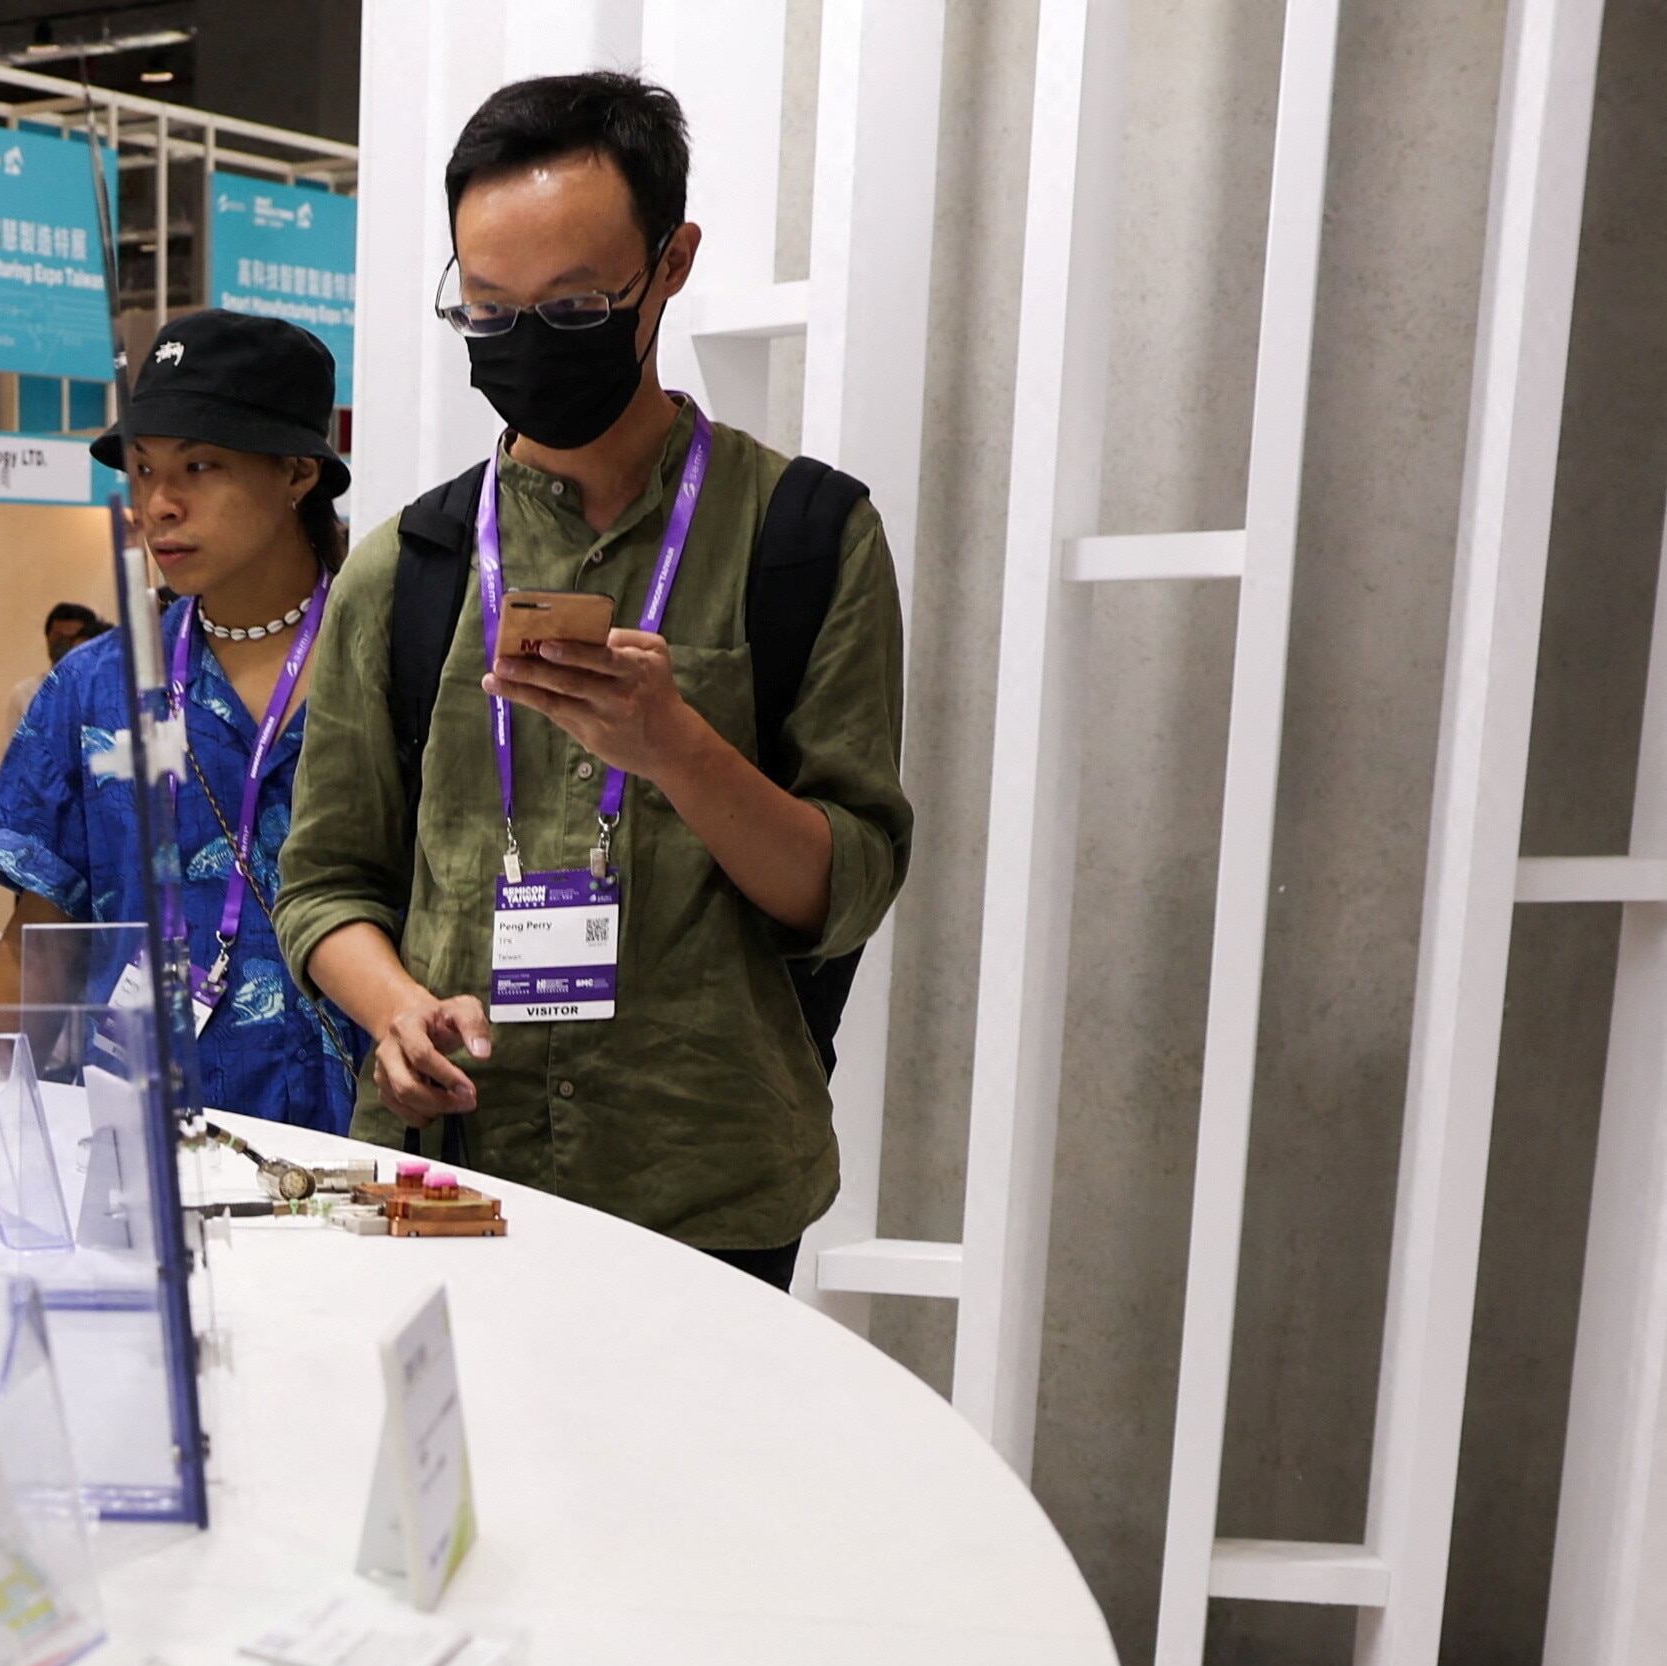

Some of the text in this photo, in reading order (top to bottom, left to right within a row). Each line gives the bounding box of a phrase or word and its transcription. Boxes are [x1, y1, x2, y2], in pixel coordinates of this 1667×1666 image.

[34, 262, 64, 287] Expo
[21, 449, 49, 467] LTD.
[499, 920, 552, 932] Peng Perry
[527, 1005, 579, 1017] VISITOR
